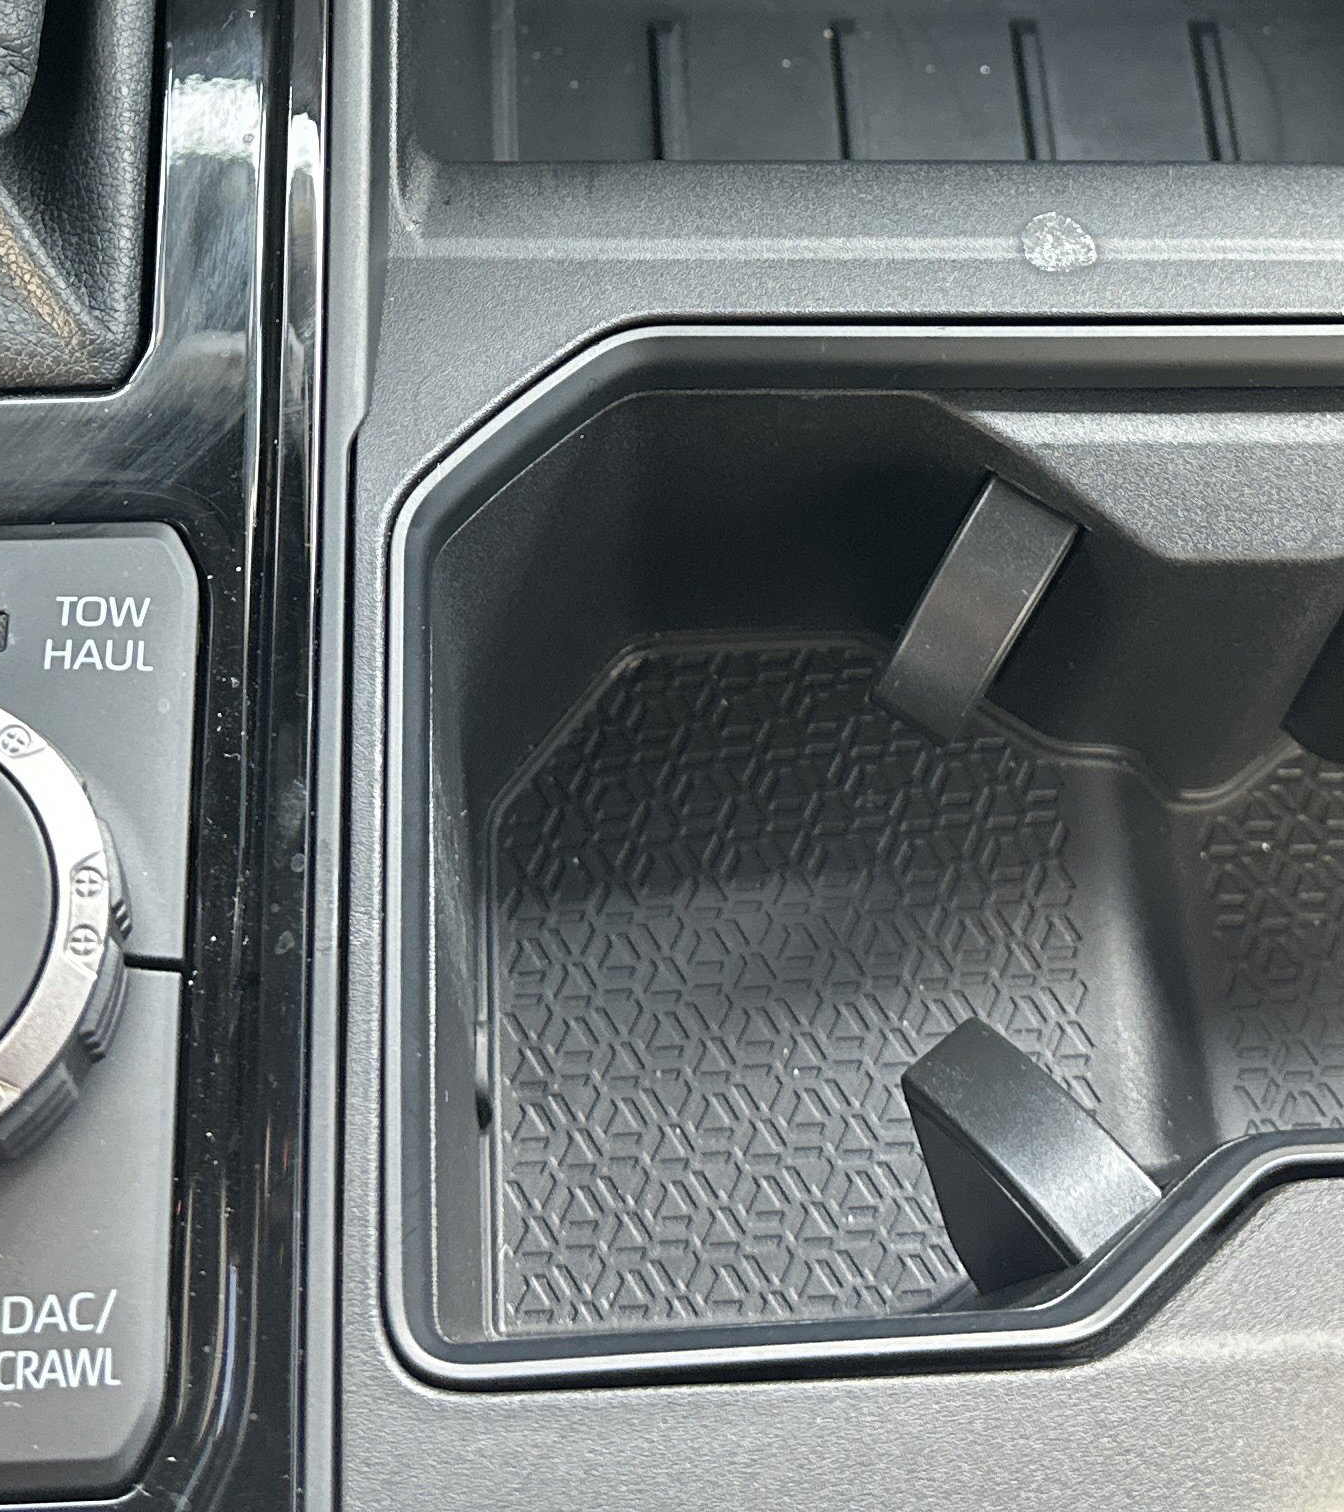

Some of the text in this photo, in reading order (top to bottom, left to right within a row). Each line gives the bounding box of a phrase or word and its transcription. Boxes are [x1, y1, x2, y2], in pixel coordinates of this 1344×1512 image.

[56, 596, 151, 628] TOW
[44, 638, 154, 672] HAUL
[0, 1288, 117, 1336] DAC/
